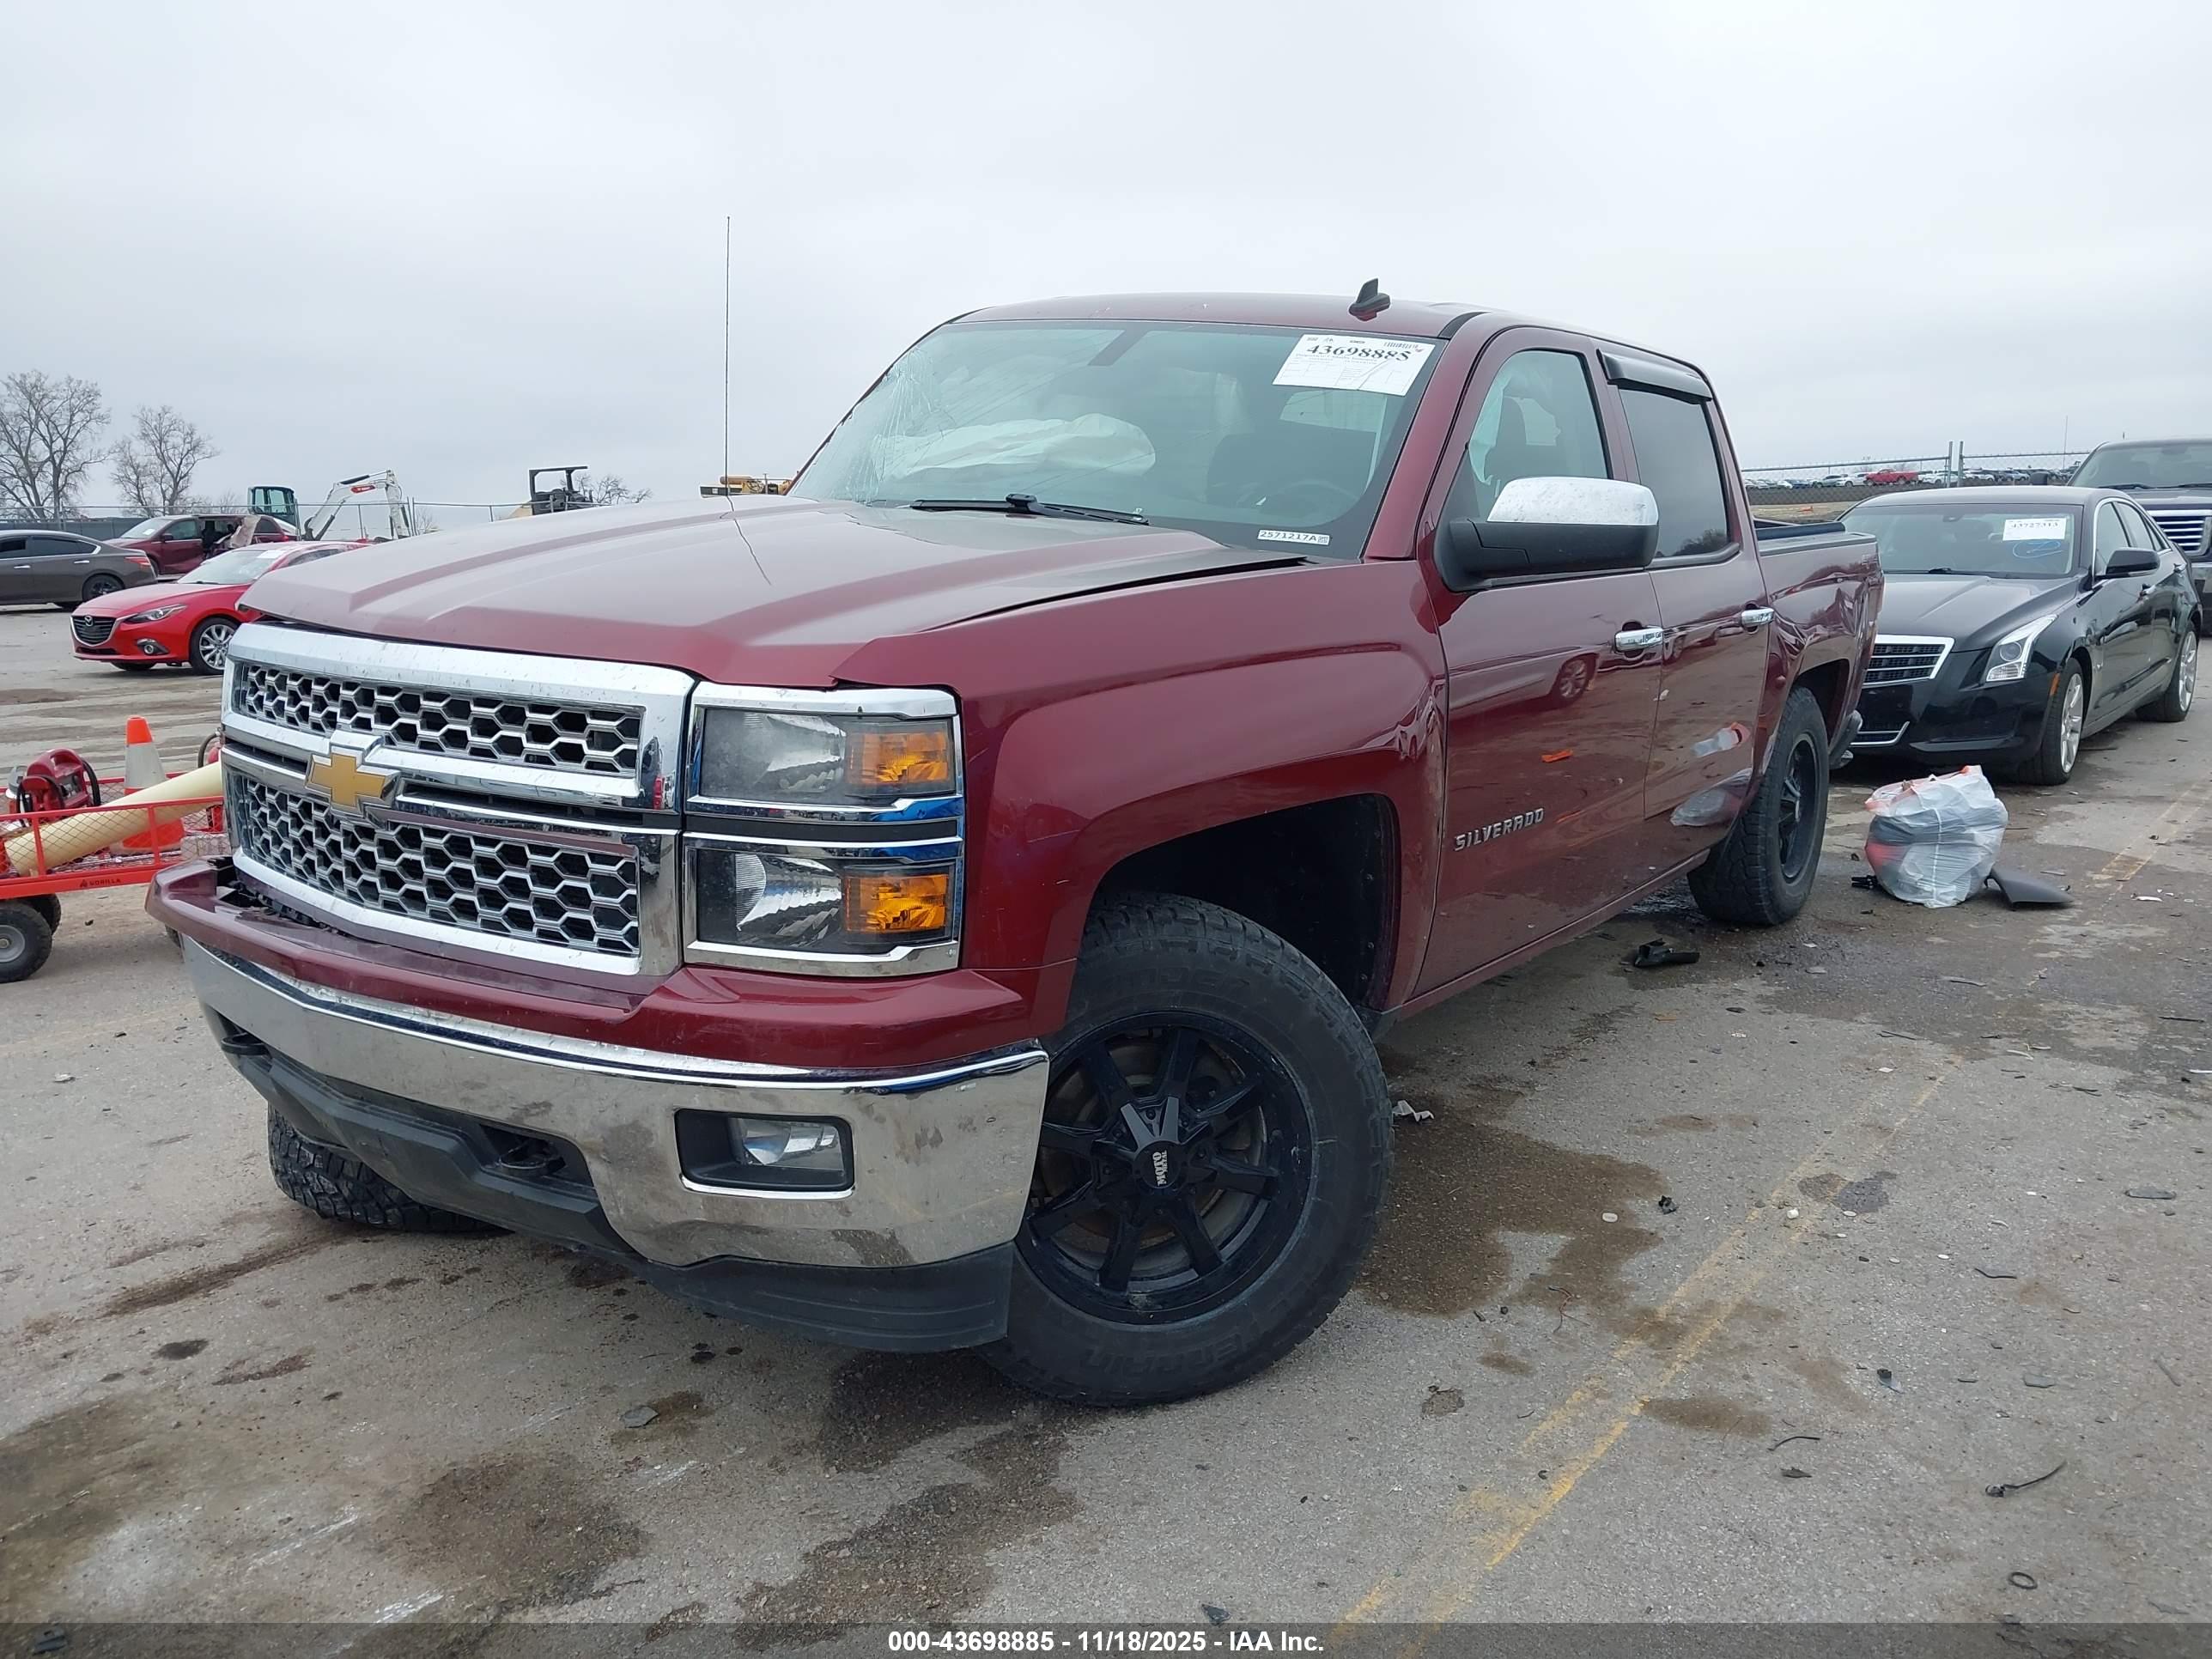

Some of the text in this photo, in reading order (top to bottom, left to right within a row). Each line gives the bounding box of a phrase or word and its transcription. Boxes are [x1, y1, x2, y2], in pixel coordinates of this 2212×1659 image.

[1306, 344, 1412, 362] 43698885
[1260, 531, 1317, 542] 2571217A
[1454, 807, 1545, 852] SILVERADO
[1152, 1152, 1168, 1187] MOTO
